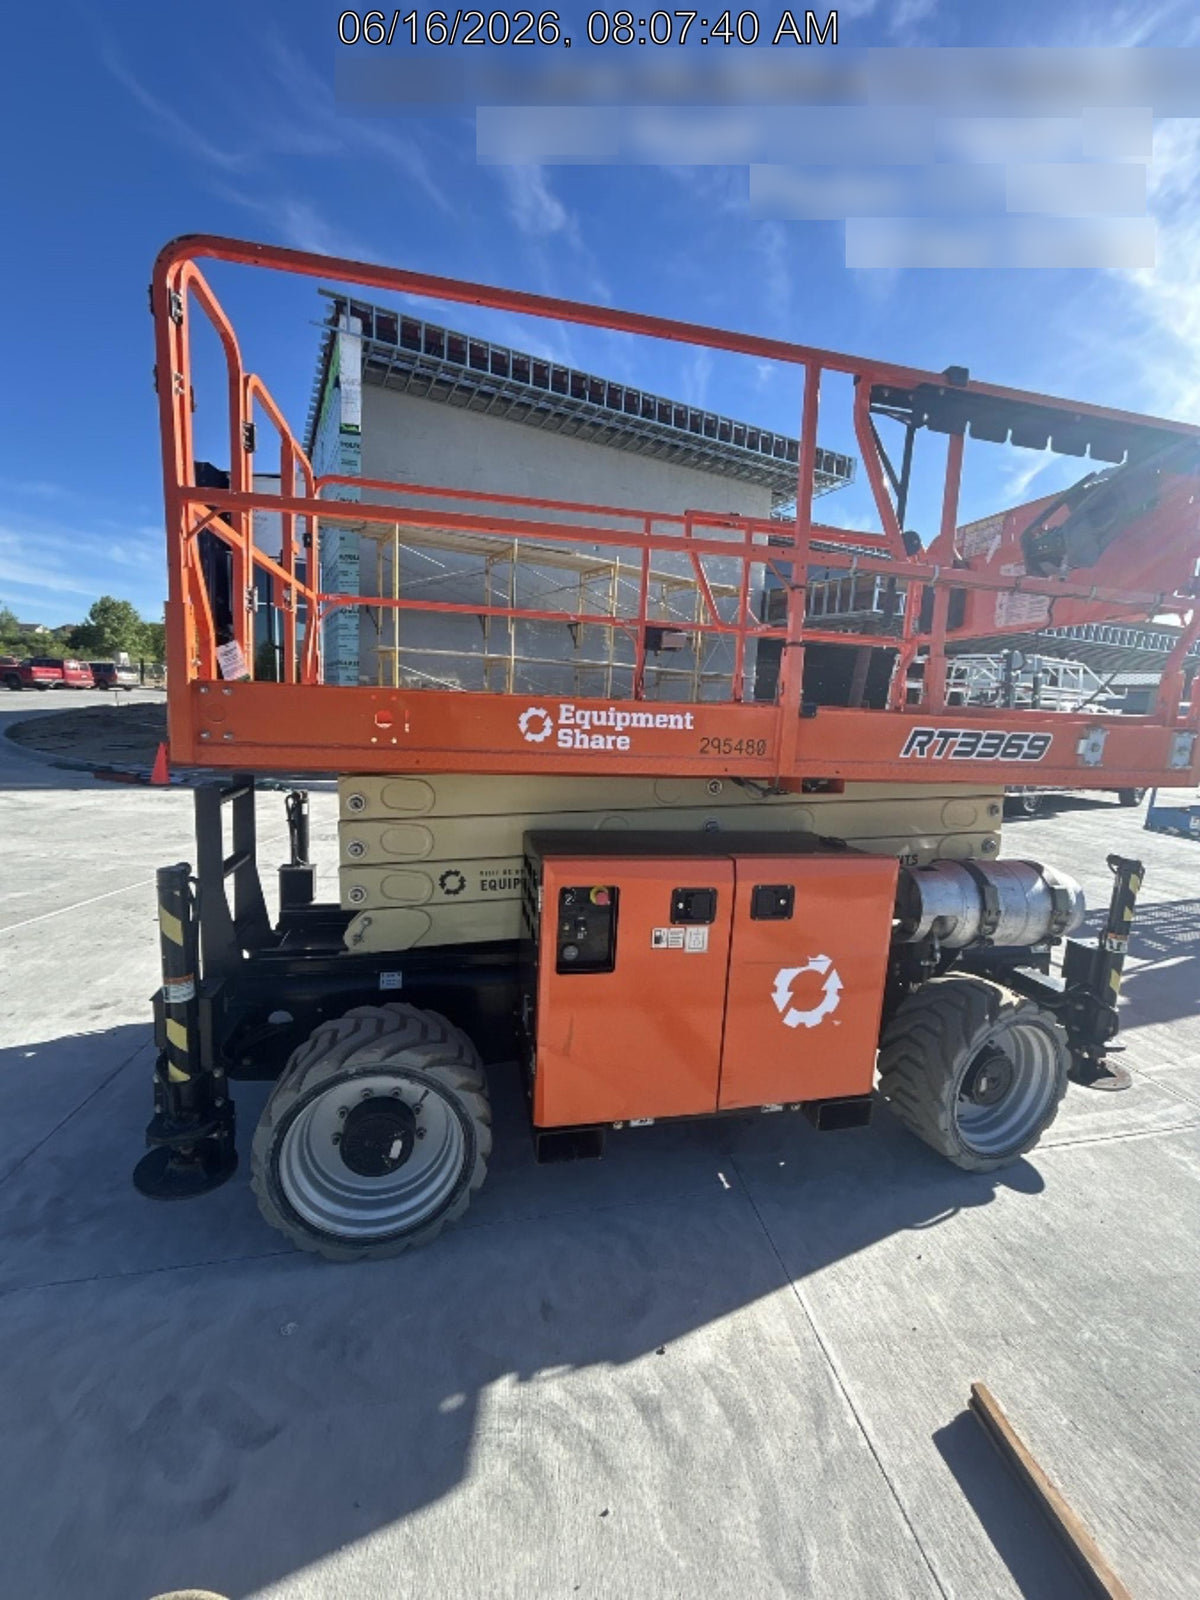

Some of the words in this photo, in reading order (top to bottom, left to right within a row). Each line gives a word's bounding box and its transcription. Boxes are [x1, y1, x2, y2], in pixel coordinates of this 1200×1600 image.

[557, 704, 694, 731] Equipment
[557, 728, 630, 750] Share
[700, 737, 767, 756] 295480
[899, 727, 1053, 761] RT3369
